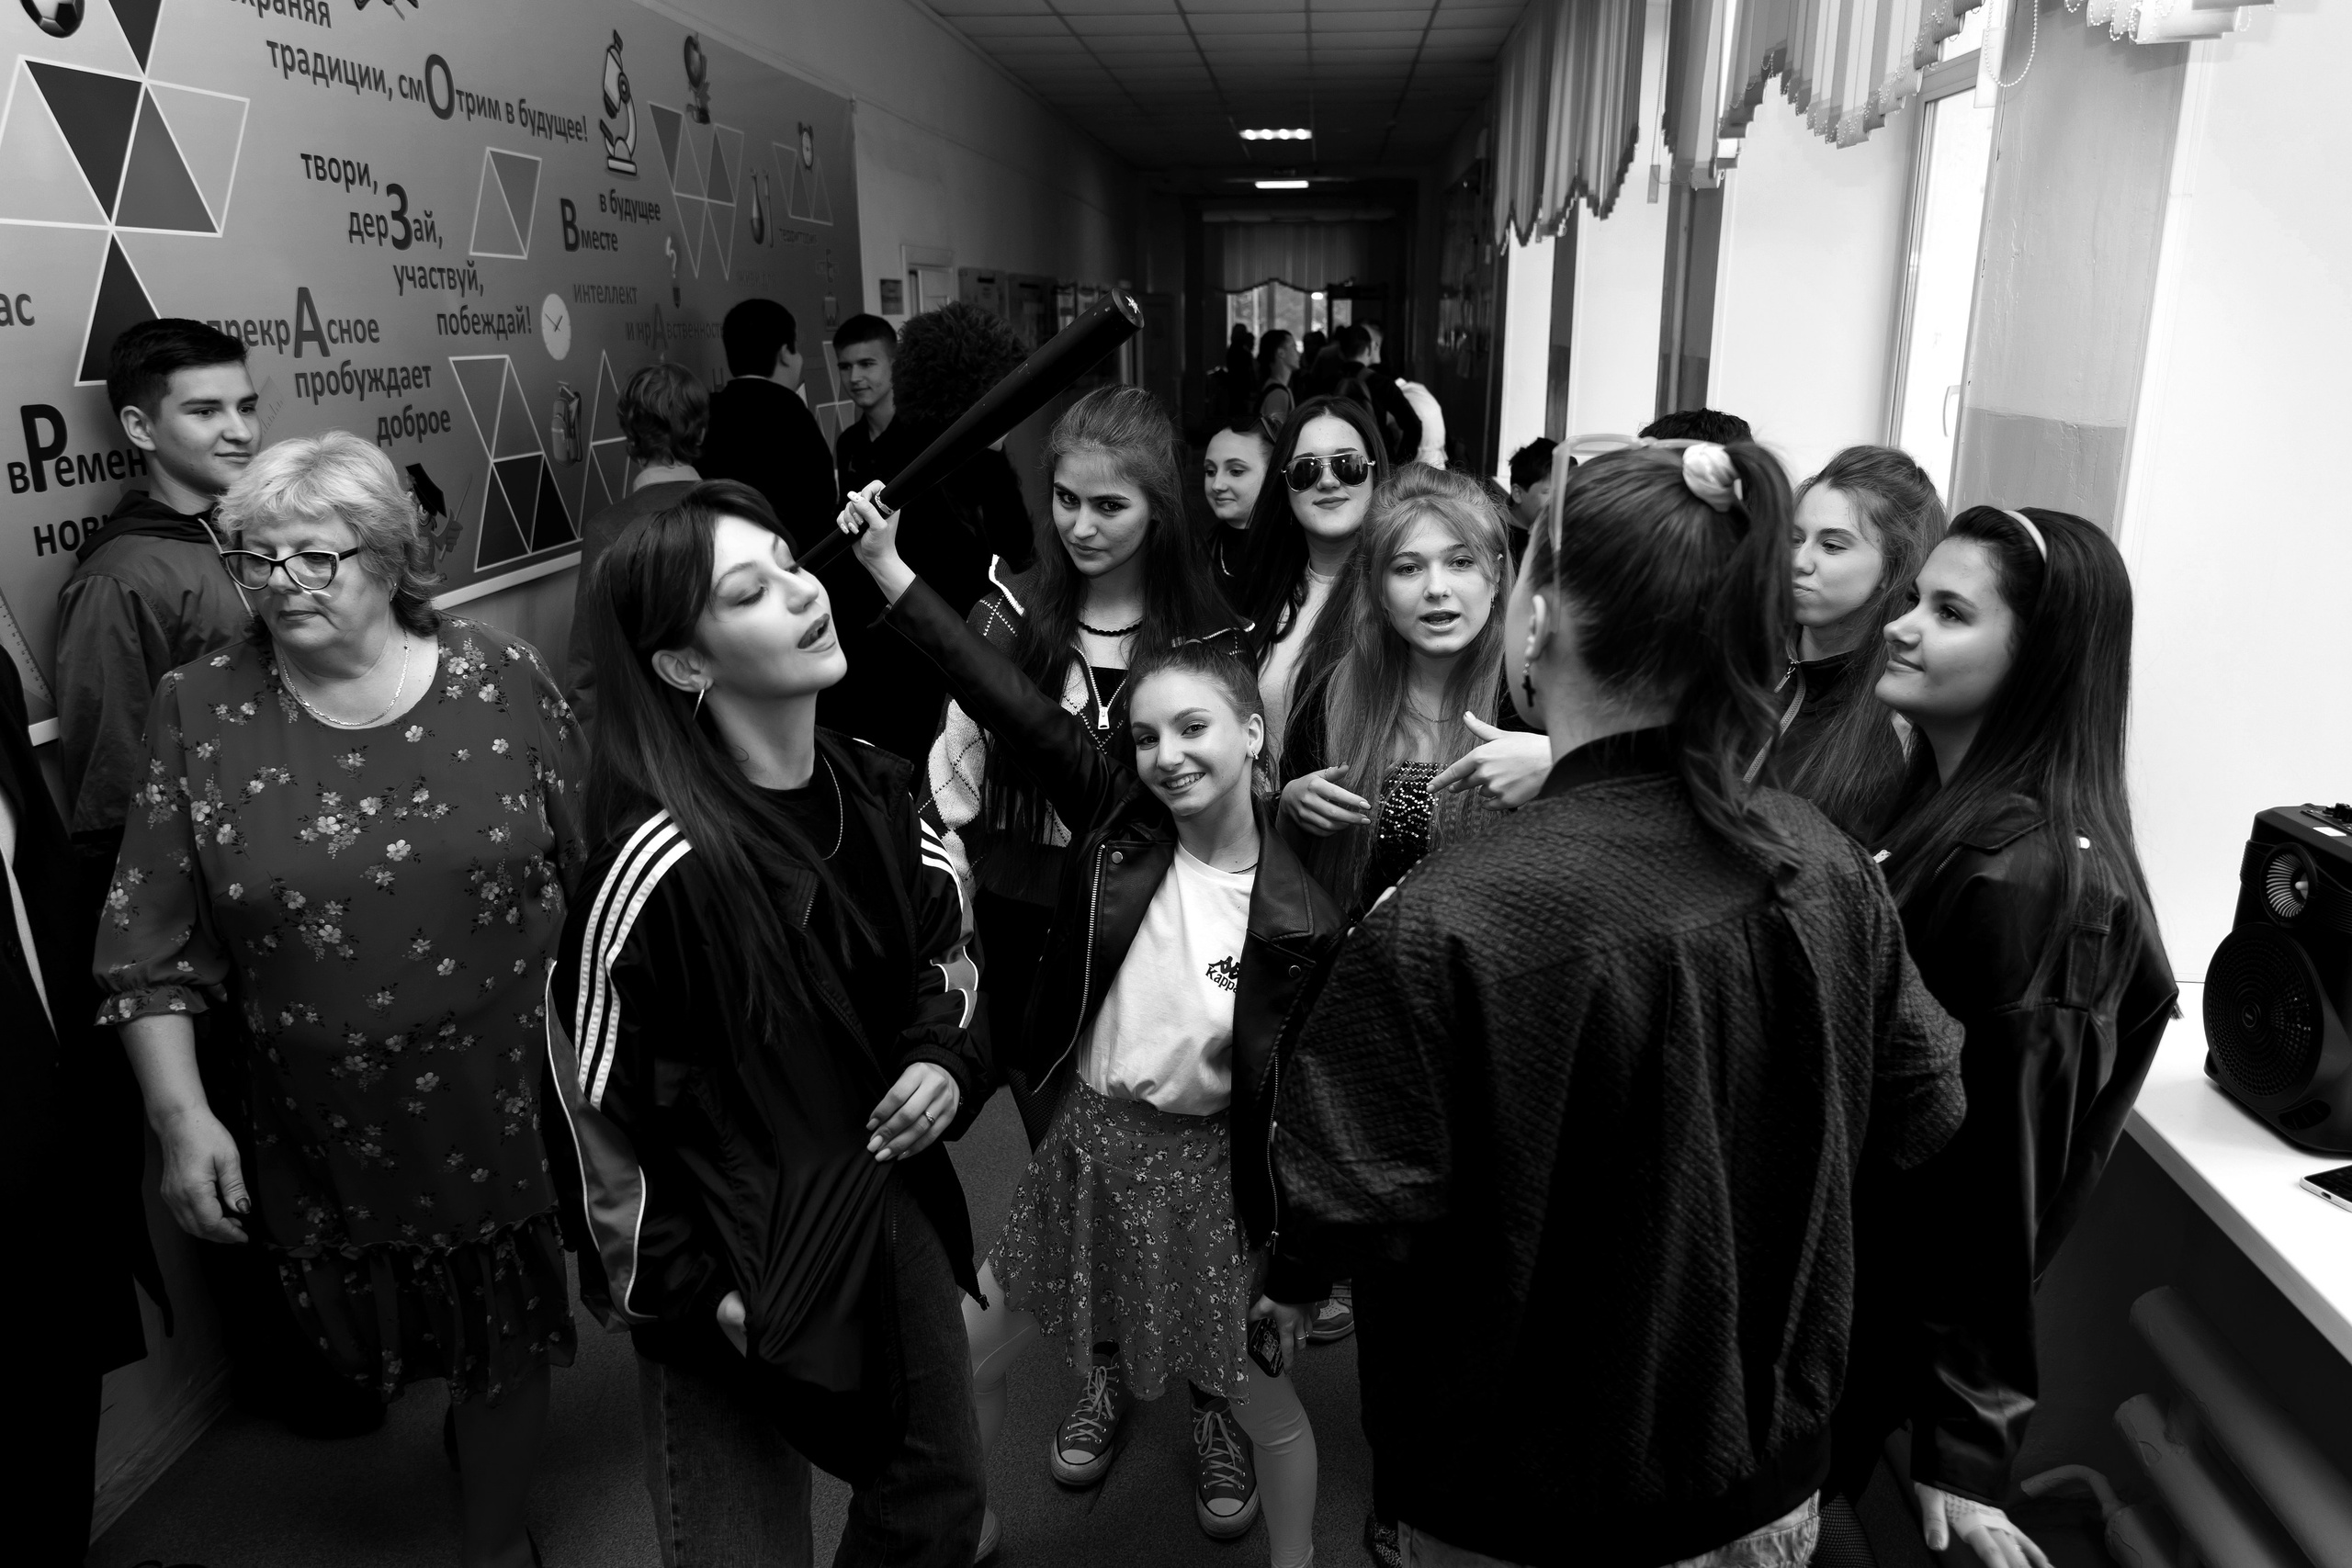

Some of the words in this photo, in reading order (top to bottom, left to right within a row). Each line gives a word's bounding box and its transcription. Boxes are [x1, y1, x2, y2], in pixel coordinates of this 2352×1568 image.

[230, 0, 332, 28] раняя
[266, 39, 393, 101] традиции,
[399, 53, 502, 122] смОтрим
[505, 102, 515, 125] в
[519, 98, 589, 143] будущее!
[300, 152, 379, 195] твори,
[348, 184, 444, 251] дерЗай,
[560, 197, 619, 253] Вместе
[599, 191, 607, 213] в
[610, 188, 662, 224] будущее
[393, 260, 484, 298] участвуй,
[573, 283, 639, 306] интеллект
[436, 305, 533, 342] побеждай!
[626, 321, 635, 341] и
[294, 360, 432, 406] пробуждает
[377, 404, 452, 447] доброе
[33, 514, 108, 557] нов
